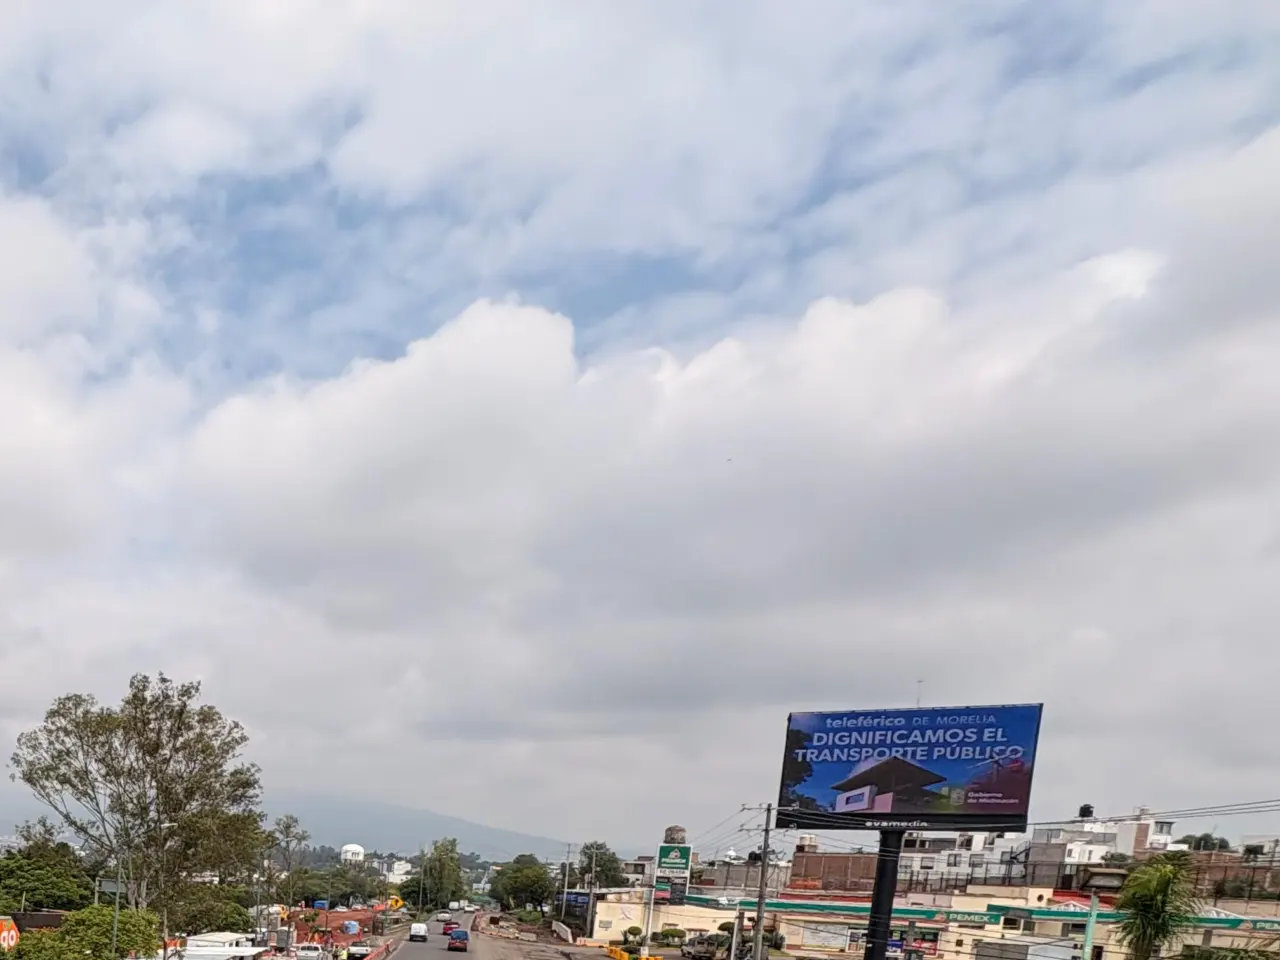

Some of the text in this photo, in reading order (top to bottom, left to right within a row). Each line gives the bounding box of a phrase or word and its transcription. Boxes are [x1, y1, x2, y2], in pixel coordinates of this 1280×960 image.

[825, 715, 997, 728] teleférico DE MORELIA
[812, 728, 1008, 746] DIGNIFICAMOS EL
[794, 744, 1024, 762] TRANSPORTE PÚBLICO
[949, 913, 990, 922] PEMEX
